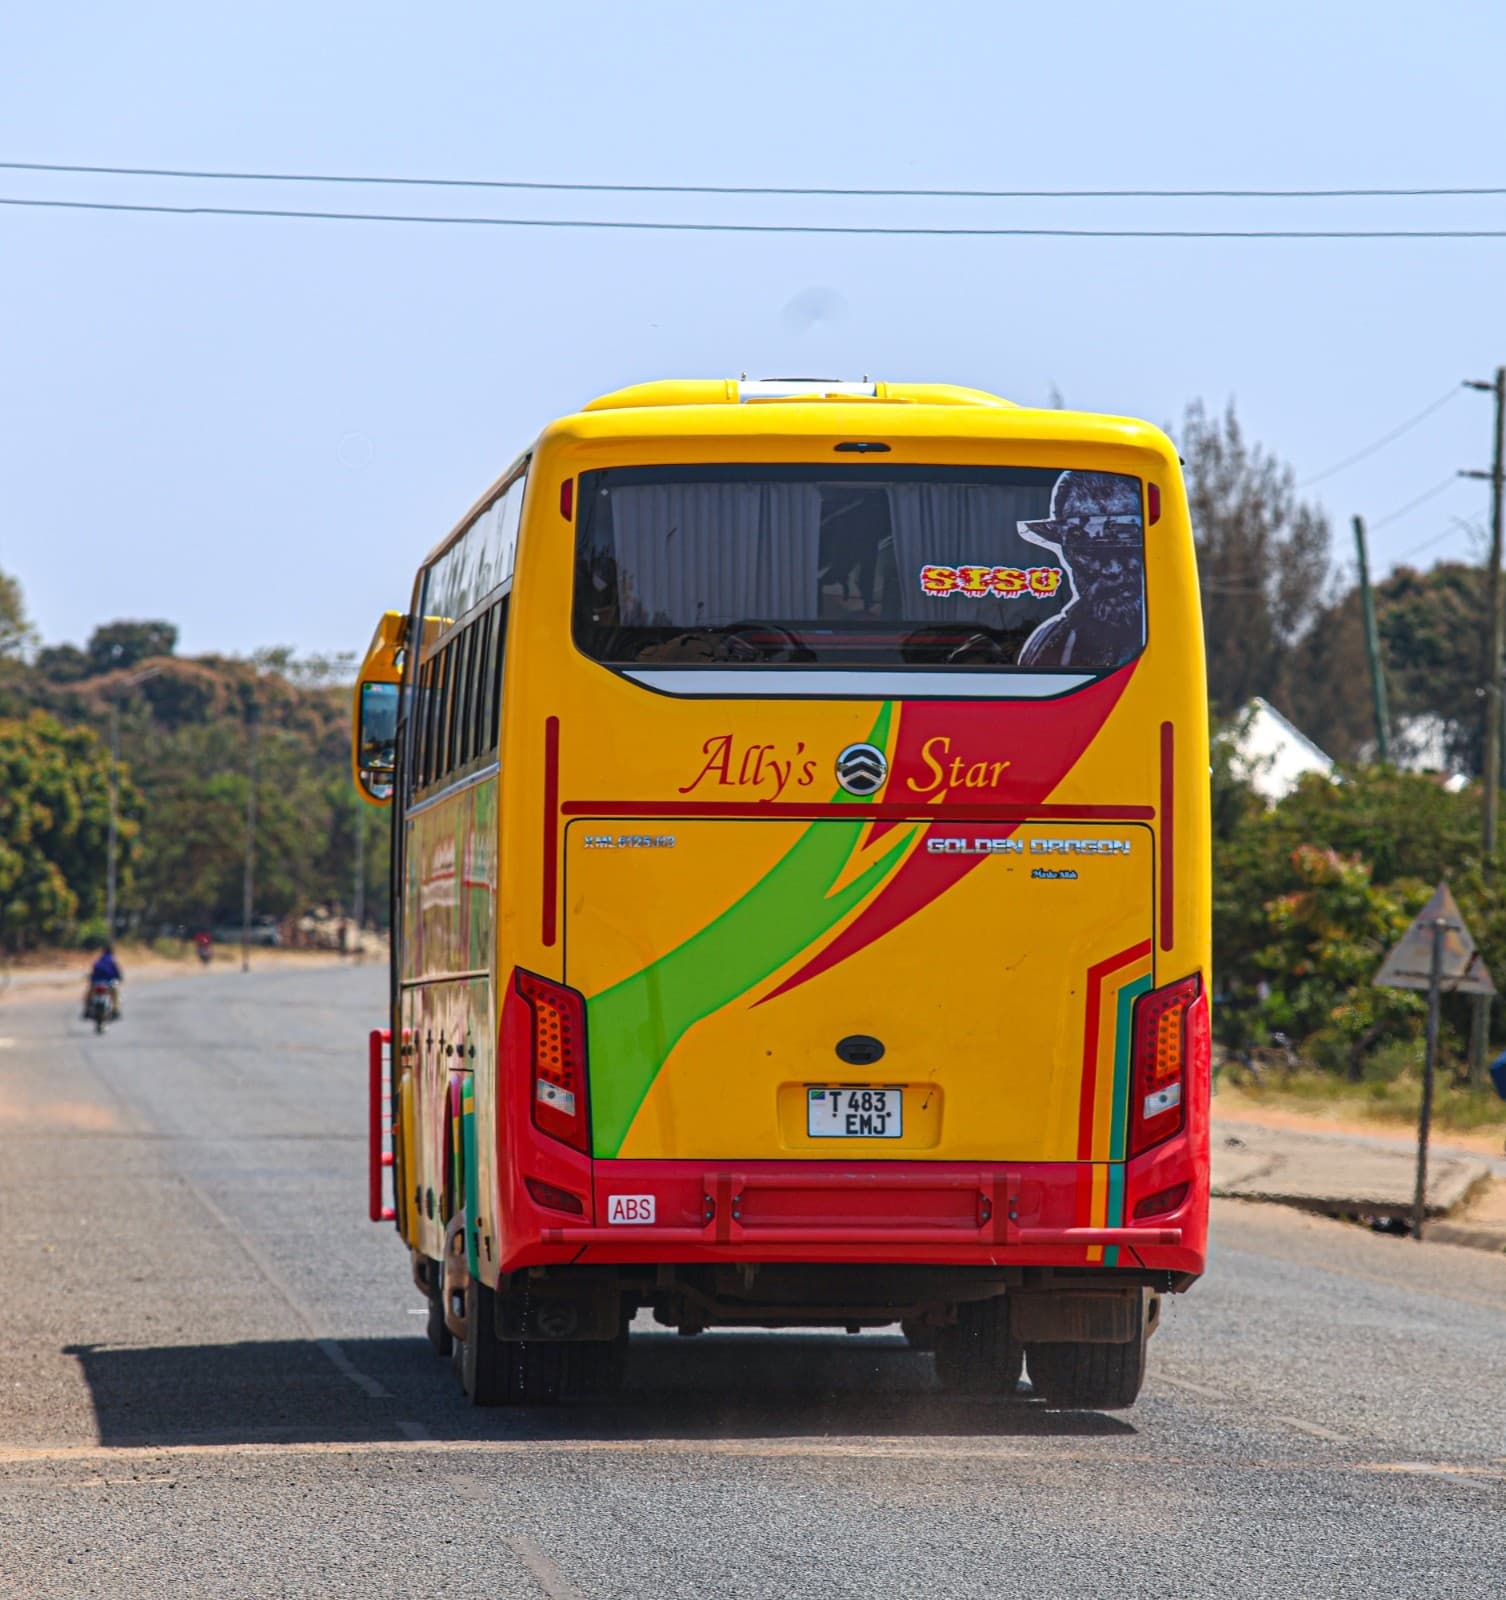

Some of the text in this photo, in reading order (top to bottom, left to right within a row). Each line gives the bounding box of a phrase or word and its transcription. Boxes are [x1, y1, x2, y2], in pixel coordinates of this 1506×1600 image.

[679, 734, 1010, 802] Ally's Star
[927, 838, 1131, 855] GOLDEN DRAGON
[829, 1091, 886, 1112] T 483
[846, 1113, 886, 1135] EMJ
[612, 1199, 651, 1220] ABS
